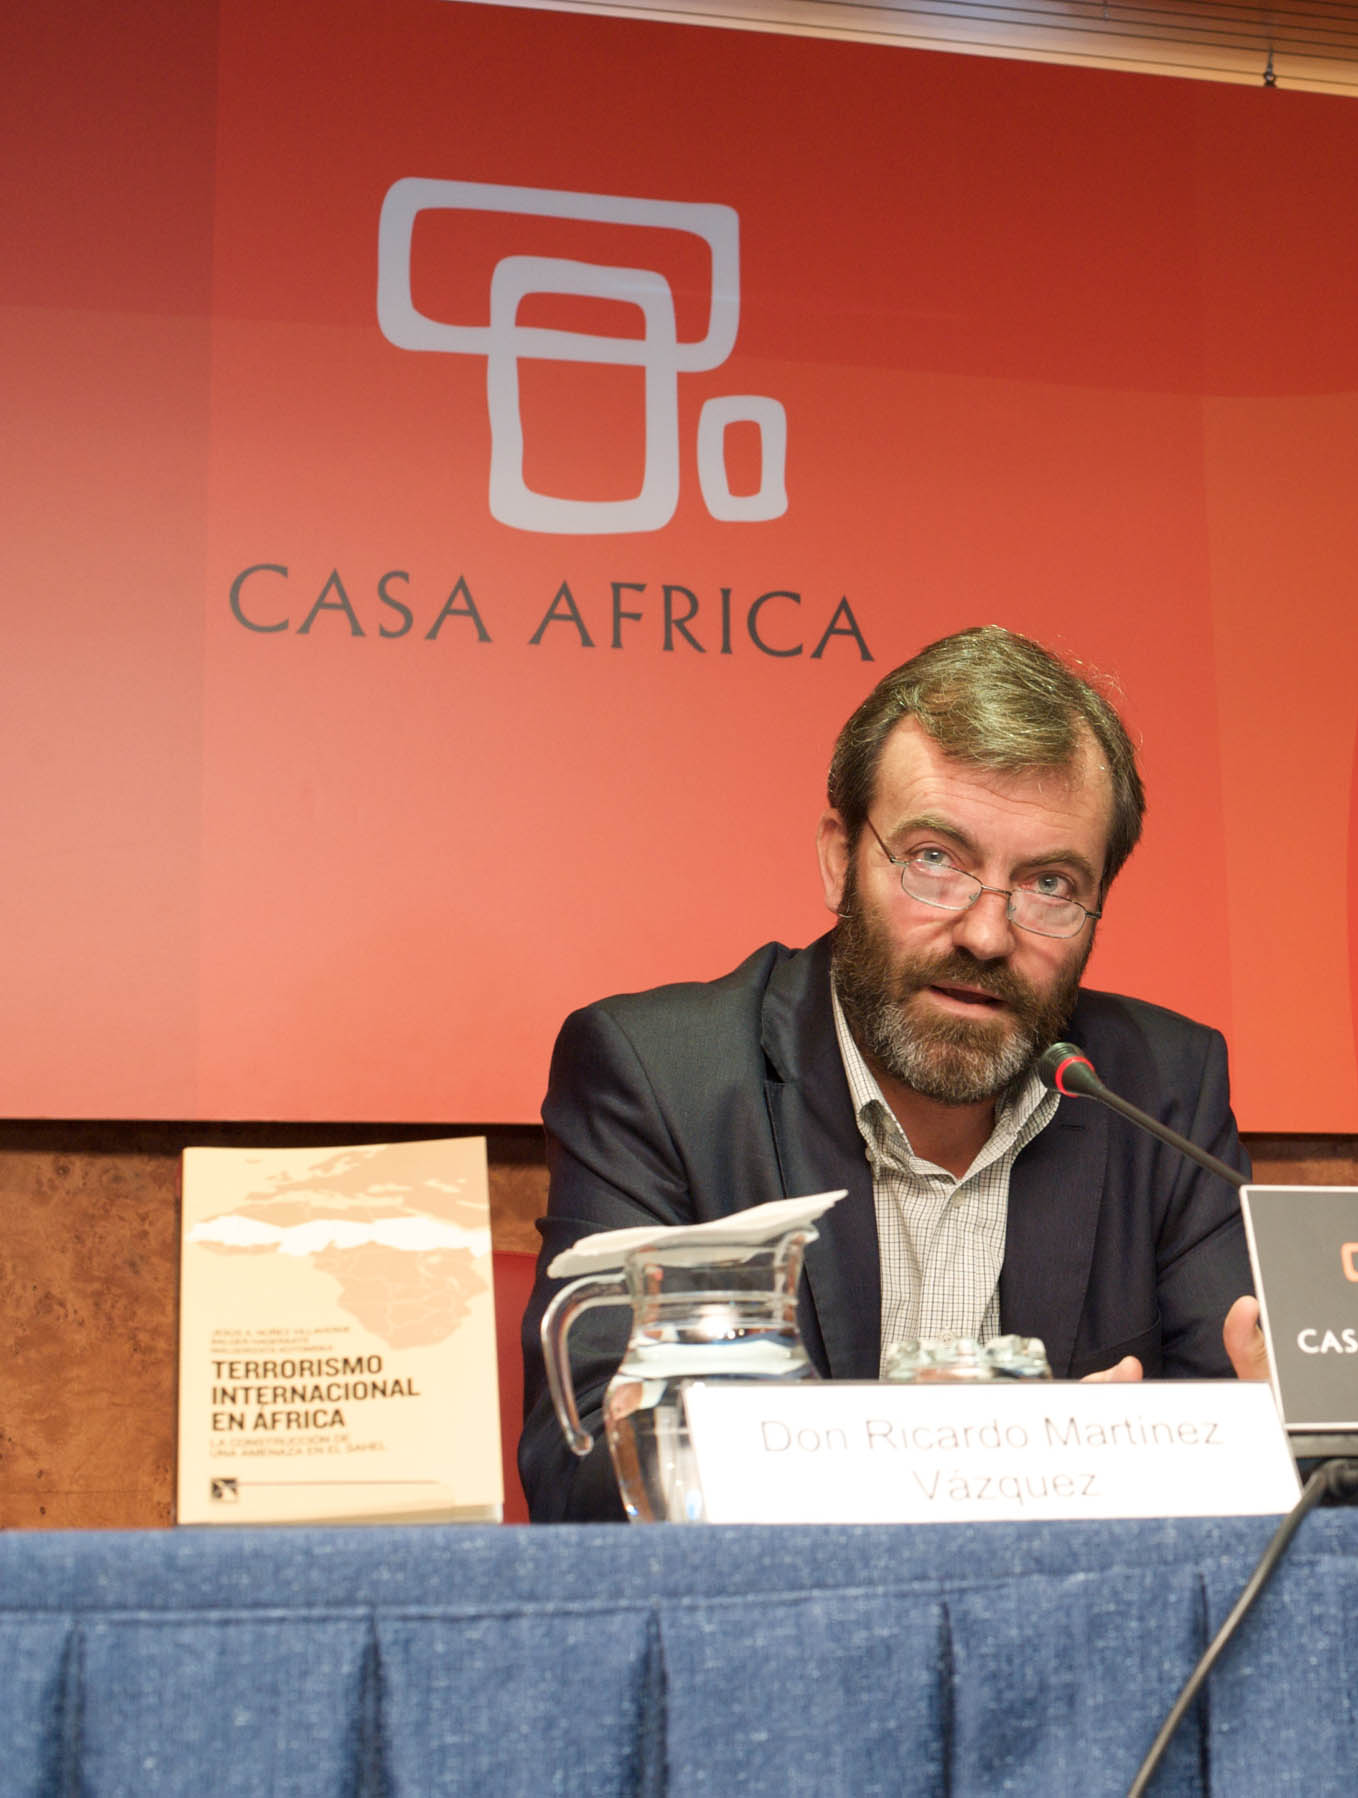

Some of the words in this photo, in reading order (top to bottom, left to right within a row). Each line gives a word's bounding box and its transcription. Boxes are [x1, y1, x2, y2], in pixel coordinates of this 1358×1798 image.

[229, 562, 493, 643] CASA
[528, 579, 875, 662] AFRICA
[211, 1354, 384, 1380] TERRORISMO
[211, 1378, 421, 1405] INTERNACIONAL
[211, 1412, 246, 1431] EN
[253, 1405, 346, 1431] ÁFRICA
[760, 1419, 849, 1452] Don
[865, 1418, 1029, 1450] Ricardo
[912, 1467, 1101, 1507] Vázquez
